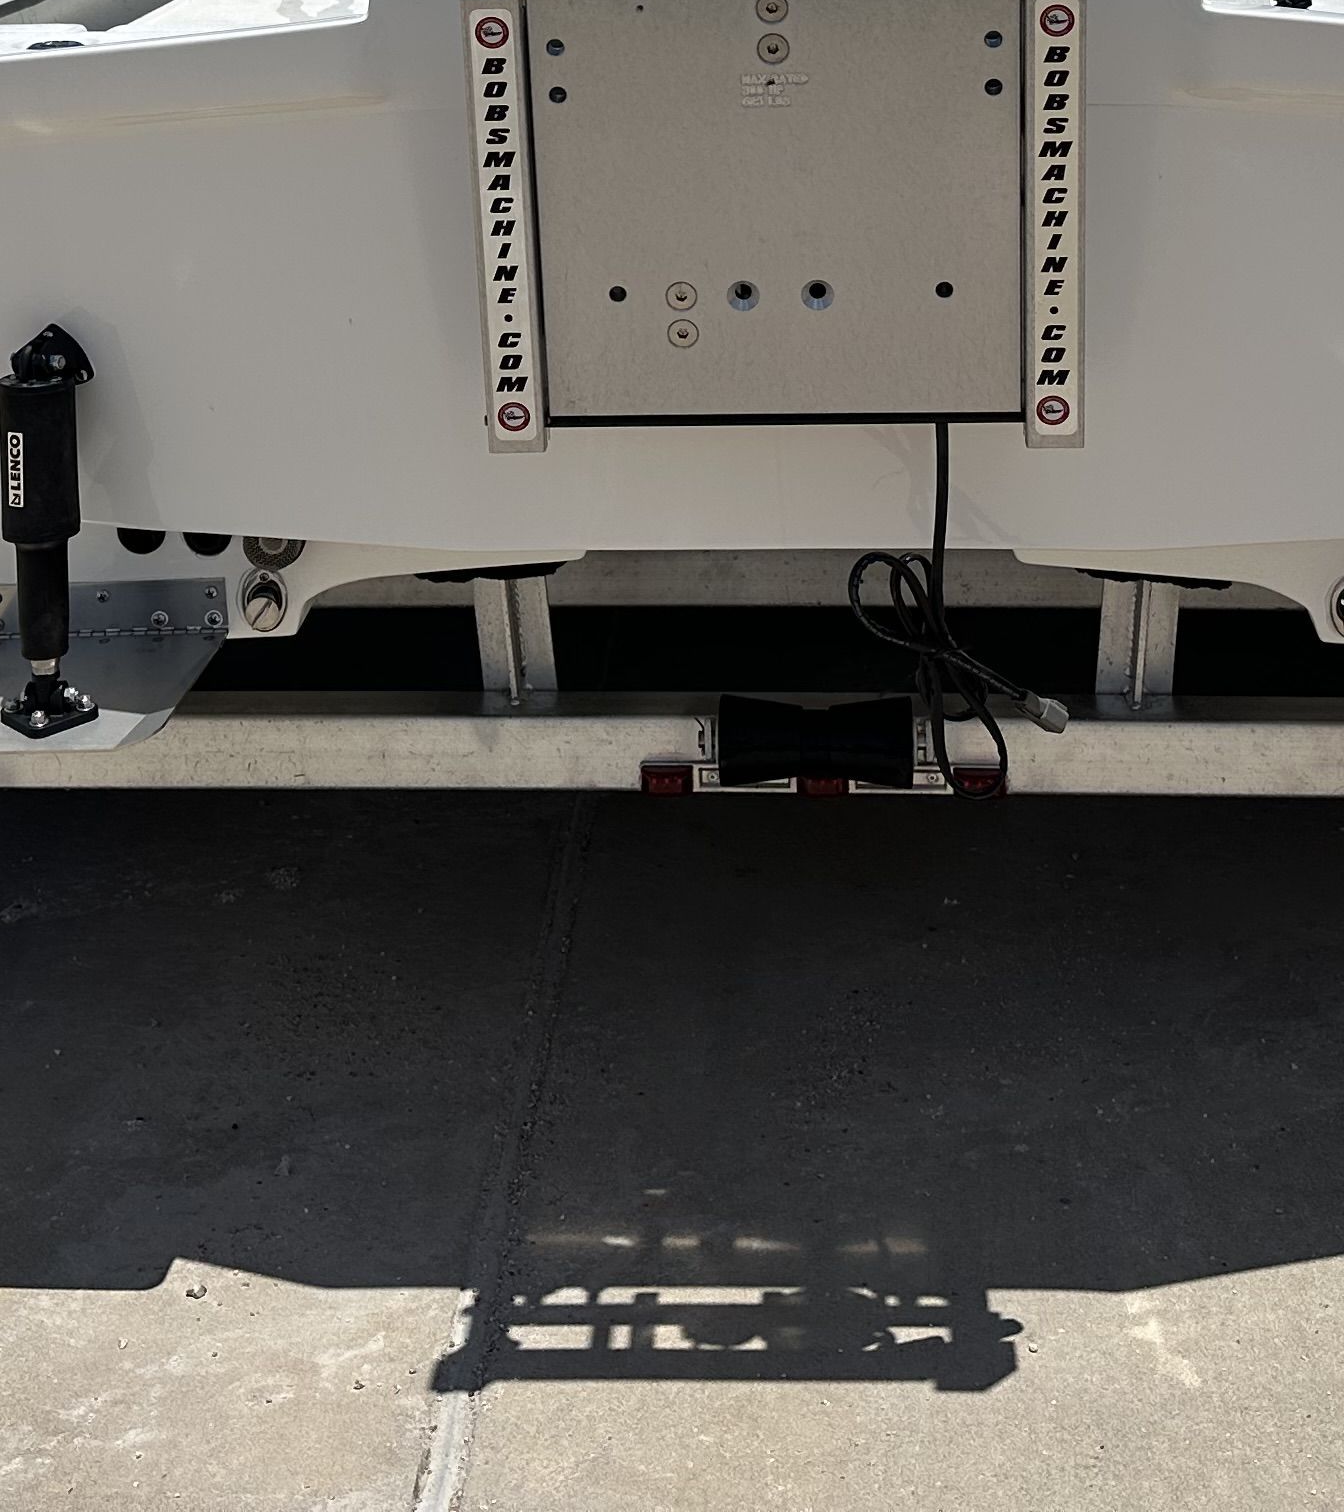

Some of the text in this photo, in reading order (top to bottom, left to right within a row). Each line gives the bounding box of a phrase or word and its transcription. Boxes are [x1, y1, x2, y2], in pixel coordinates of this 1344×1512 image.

[481, 57, 529, 393] BOBSMACHINE.COM
[1037, 46, 1073, 386] BOBSMACHINE.COM
[9, 434, 21, 491] LENCO
